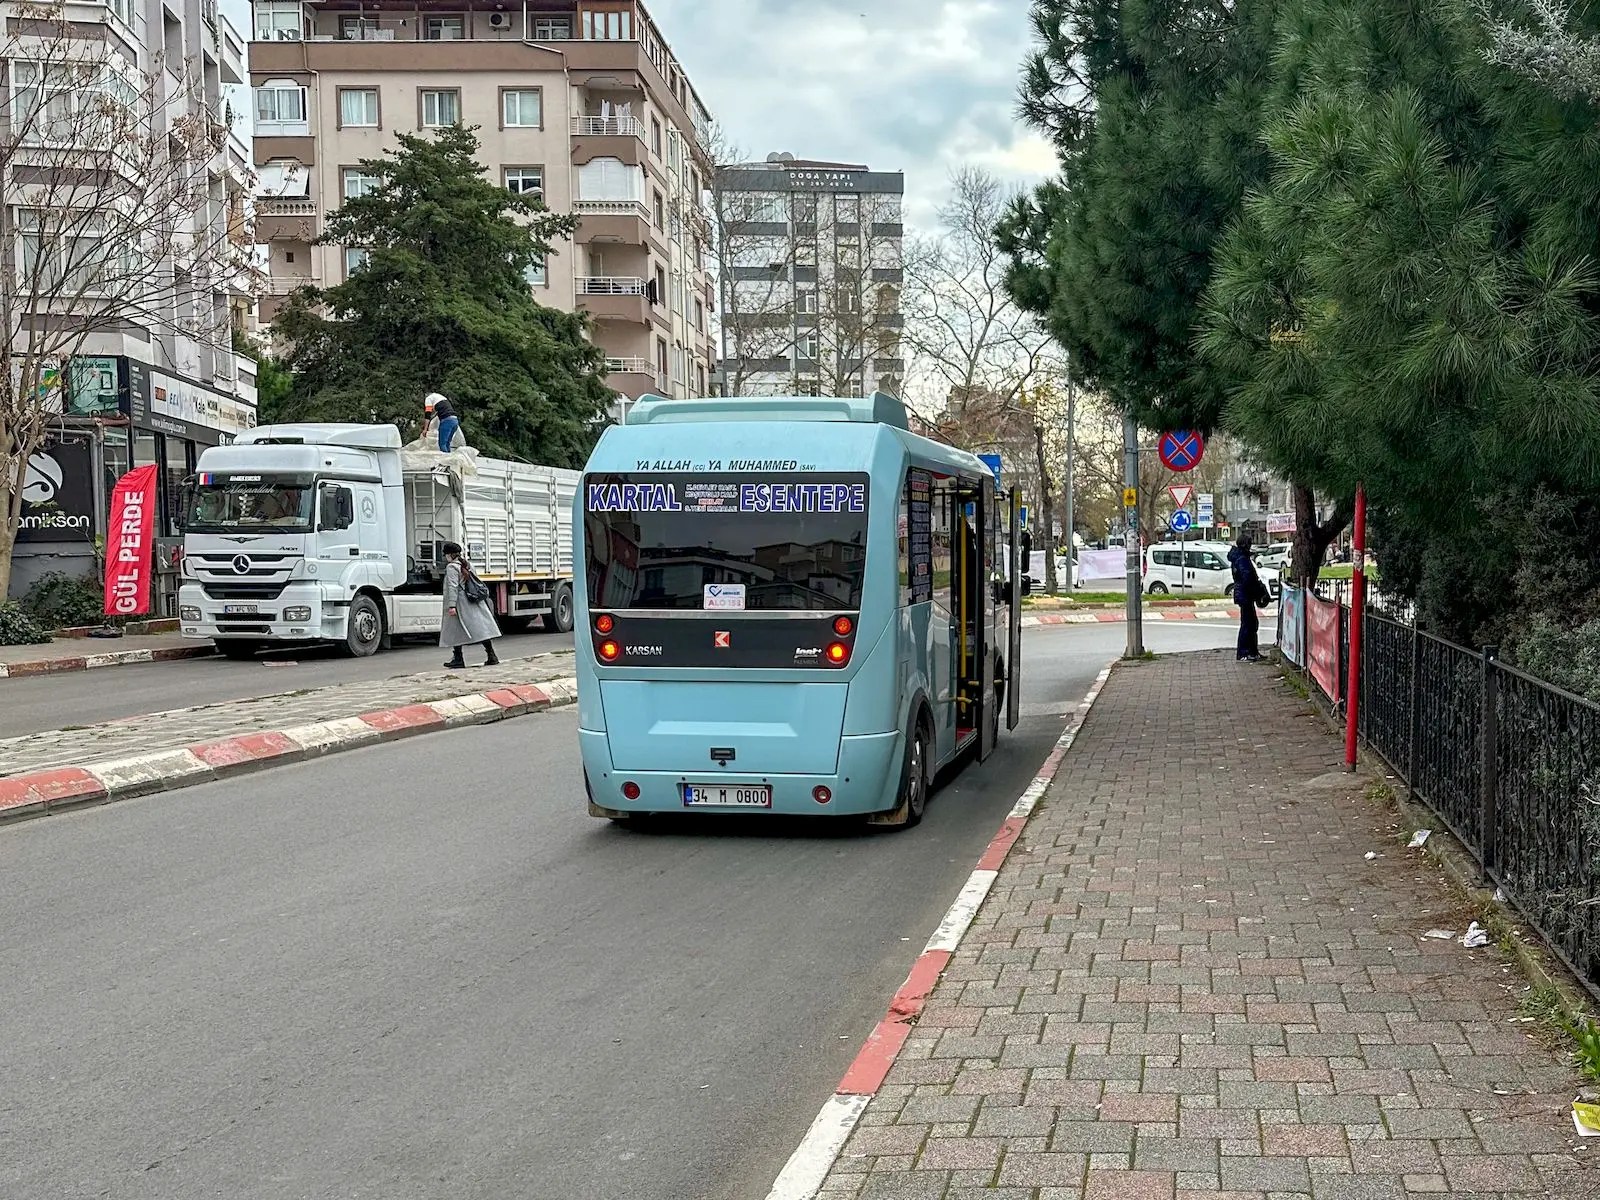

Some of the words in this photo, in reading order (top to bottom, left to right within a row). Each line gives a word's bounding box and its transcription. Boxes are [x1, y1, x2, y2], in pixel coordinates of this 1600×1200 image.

[636, 460, 649, 471] YA
[652, 460, 692, 471] ALLAH
[708, 460, 721, 471] YA
[728, 460, 798, 471] MUHAMMED
[588, 483, 683, 512] KARTAL
[739, 483, 865, 513] ESENTEPE
[119, 491, 144, 562] PERDE
[113, 568, 139, 613] GÜL
[625, 645, 663, 655] KARSAN
[693, 789, 708, 803] 34
[719, 789, 727, 803] M
[736, 790, 767, 804] 0800
